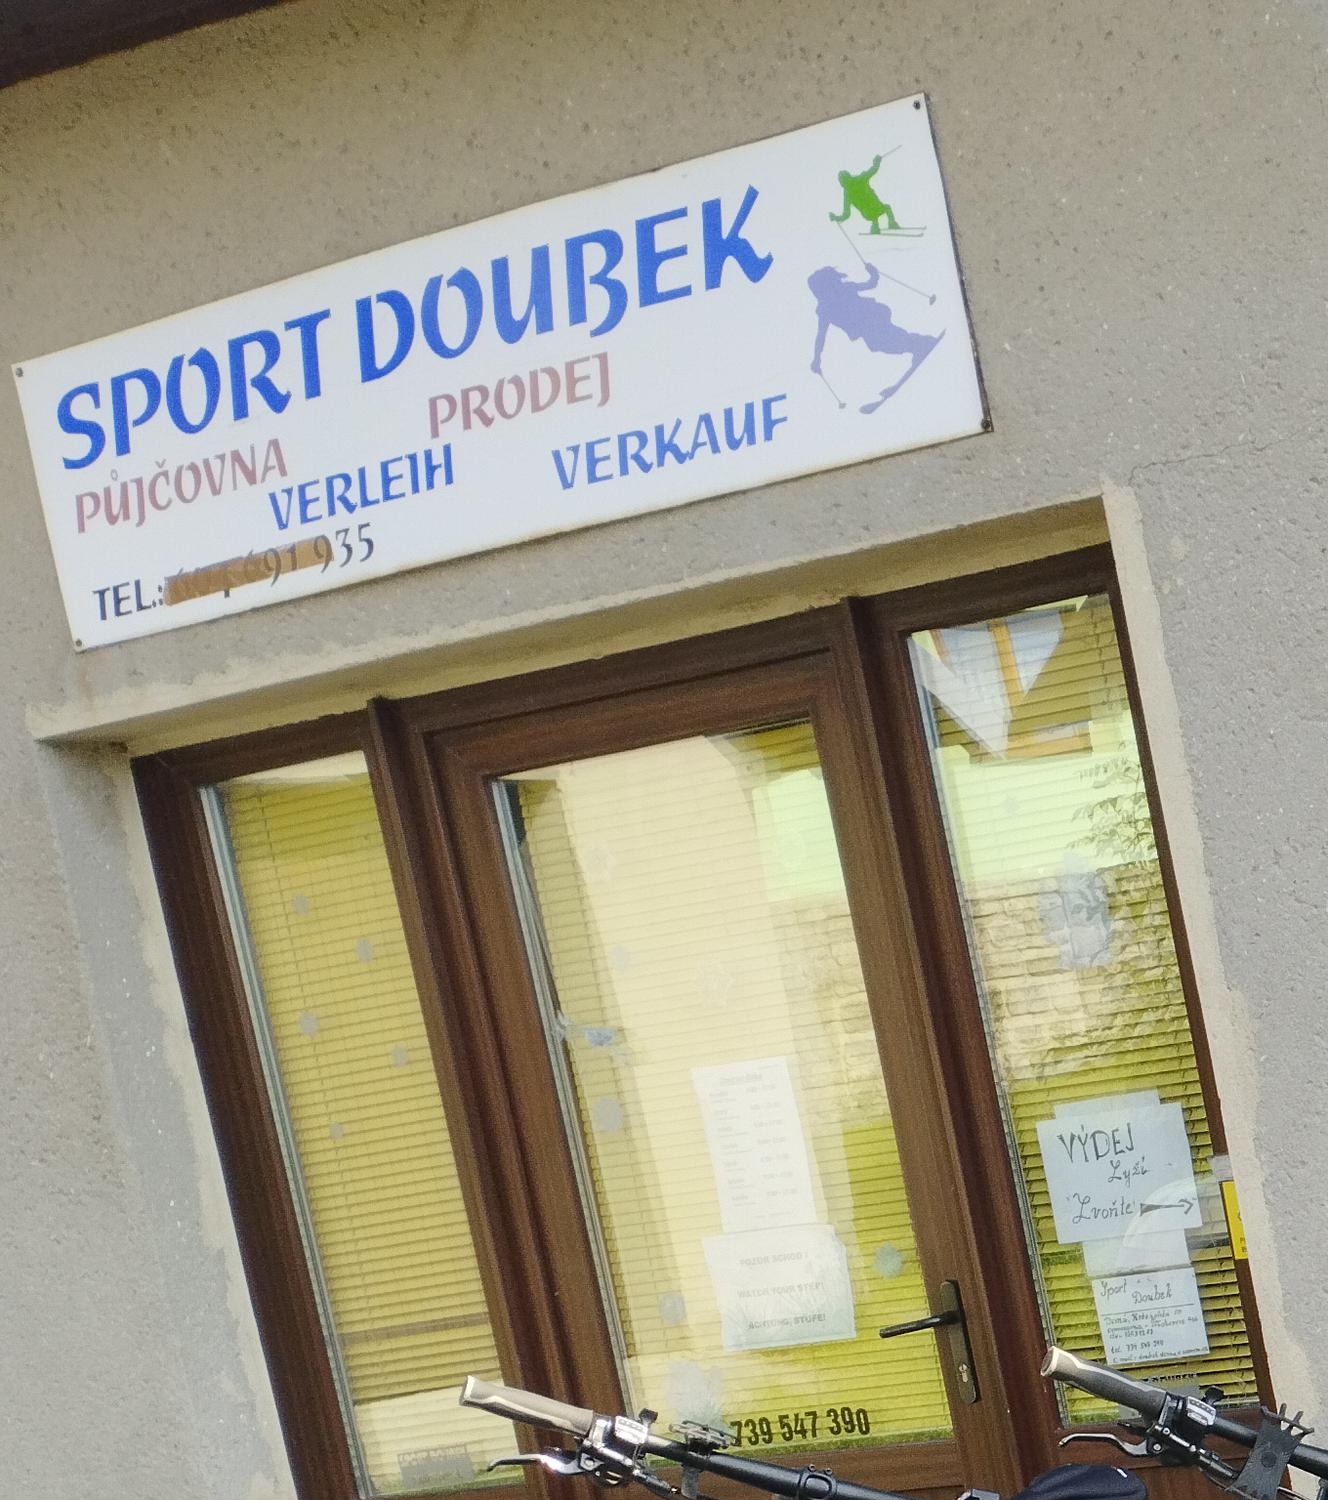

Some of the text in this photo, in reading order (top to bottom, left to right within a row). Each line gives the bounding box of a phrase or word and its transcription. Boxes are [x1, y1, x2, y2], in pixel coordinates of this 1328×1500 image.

[56, 184, 774, 470] SPORT DOUBEK
[428, 352, 612, 439] PRODEJ
[75, 437, 289, 534] PŮJČOVNA
[268, 393, 791, 531] VERLEIH VERKAUF
[1056, 1121, 1134, 1163] VÝDEJ
[729, 1406, 871, 1447] 739 547 390
